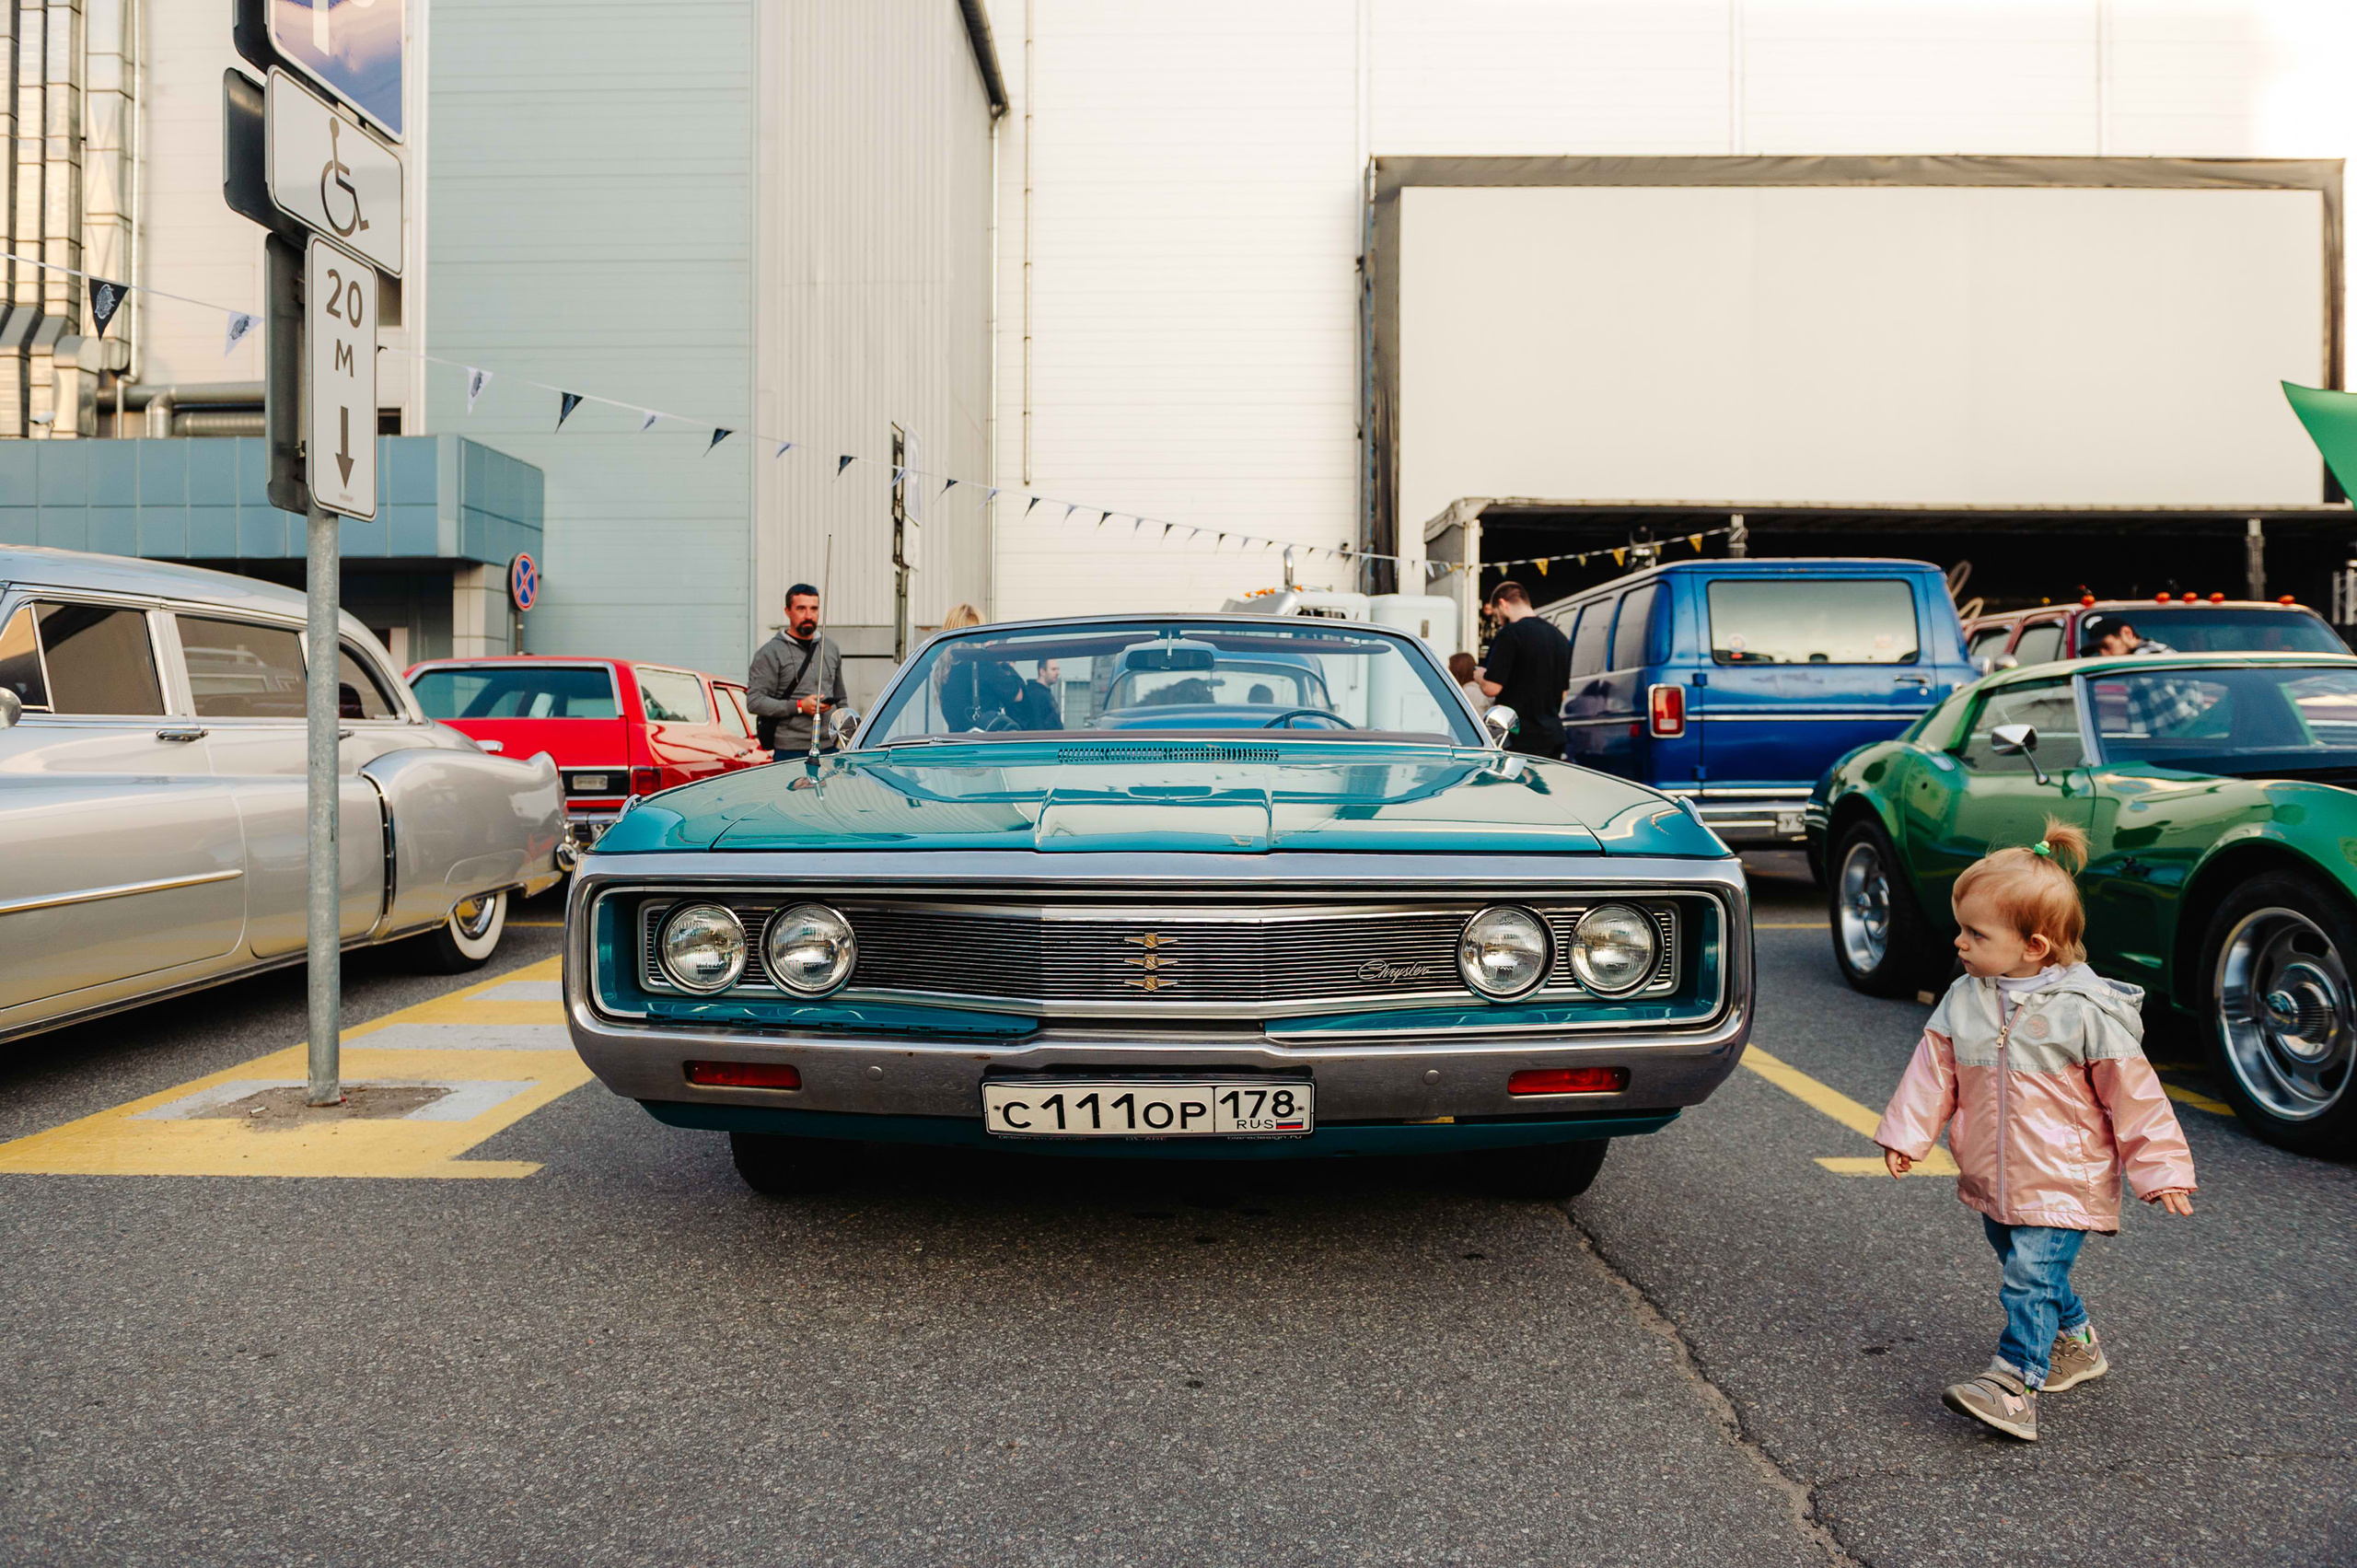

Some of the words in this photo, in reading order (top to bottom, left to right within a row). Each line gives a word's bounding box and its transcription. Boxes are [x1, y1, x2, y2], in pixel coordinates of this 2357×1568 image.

[326, 268, 363, 329] 20
[1357, 958, 1430, 983] Chrysler
[1218, 1089, 1295, 1119] 178
[1236, 1119, 1274, 1130] RUS
[2001, 1392, 2025, 1417] N
